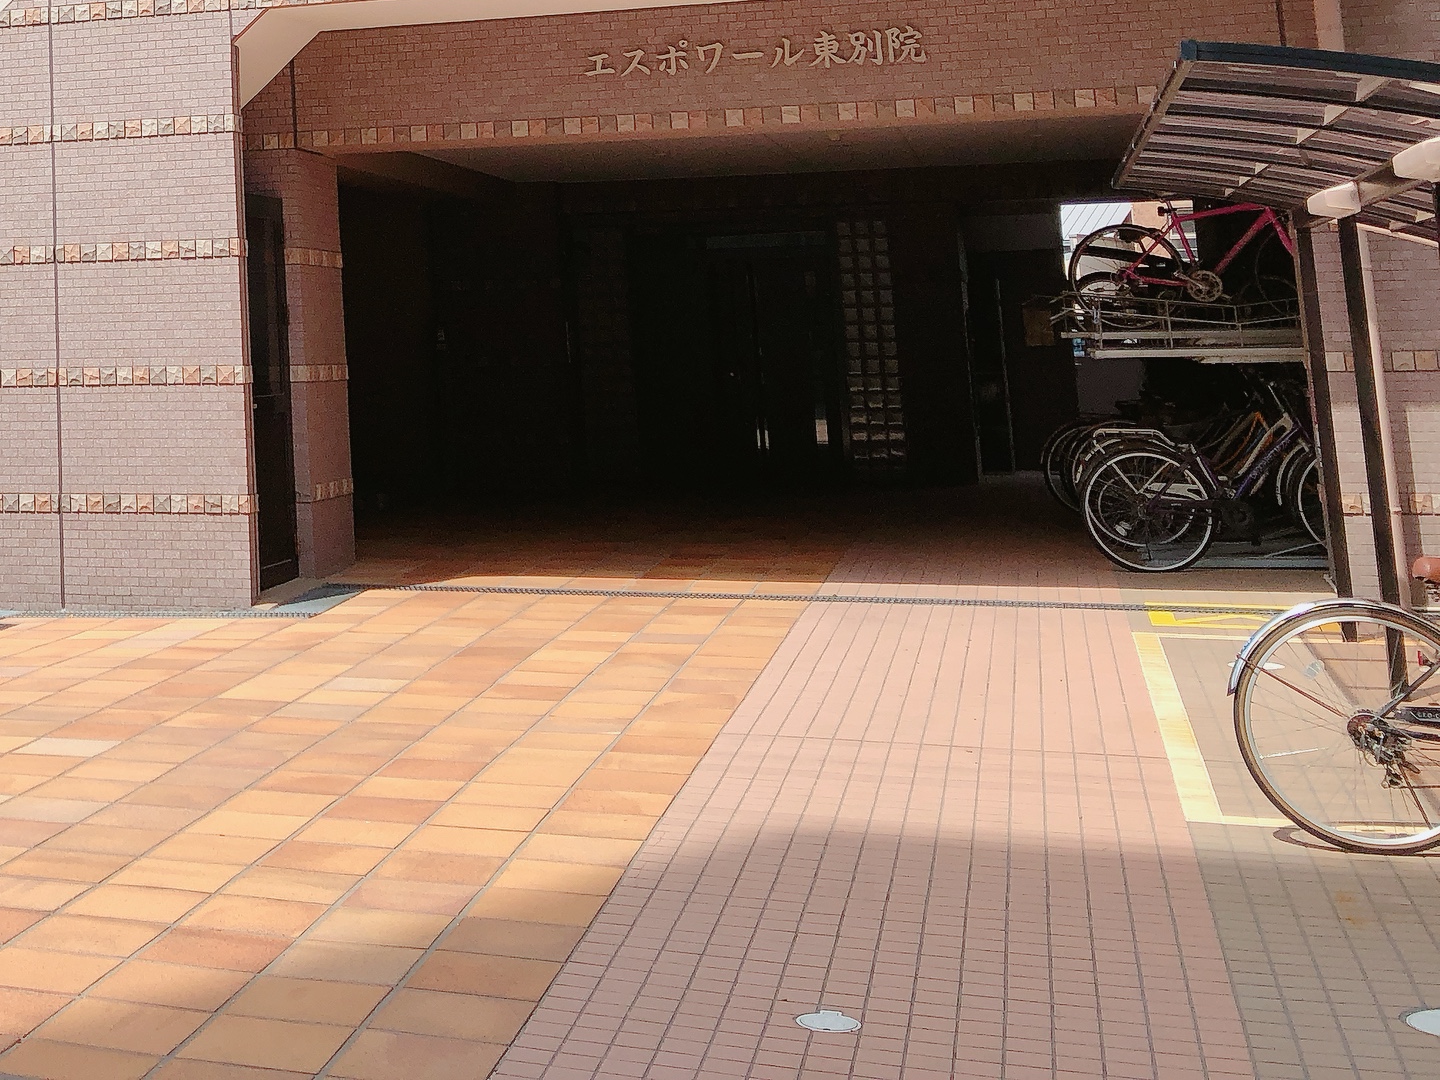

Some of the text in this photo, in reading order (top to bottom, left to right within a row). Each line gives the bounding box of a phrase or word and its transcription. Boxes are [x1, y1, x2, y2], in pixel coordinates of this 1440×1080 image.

[584, 25, 927, 77] エスポワール東別院
